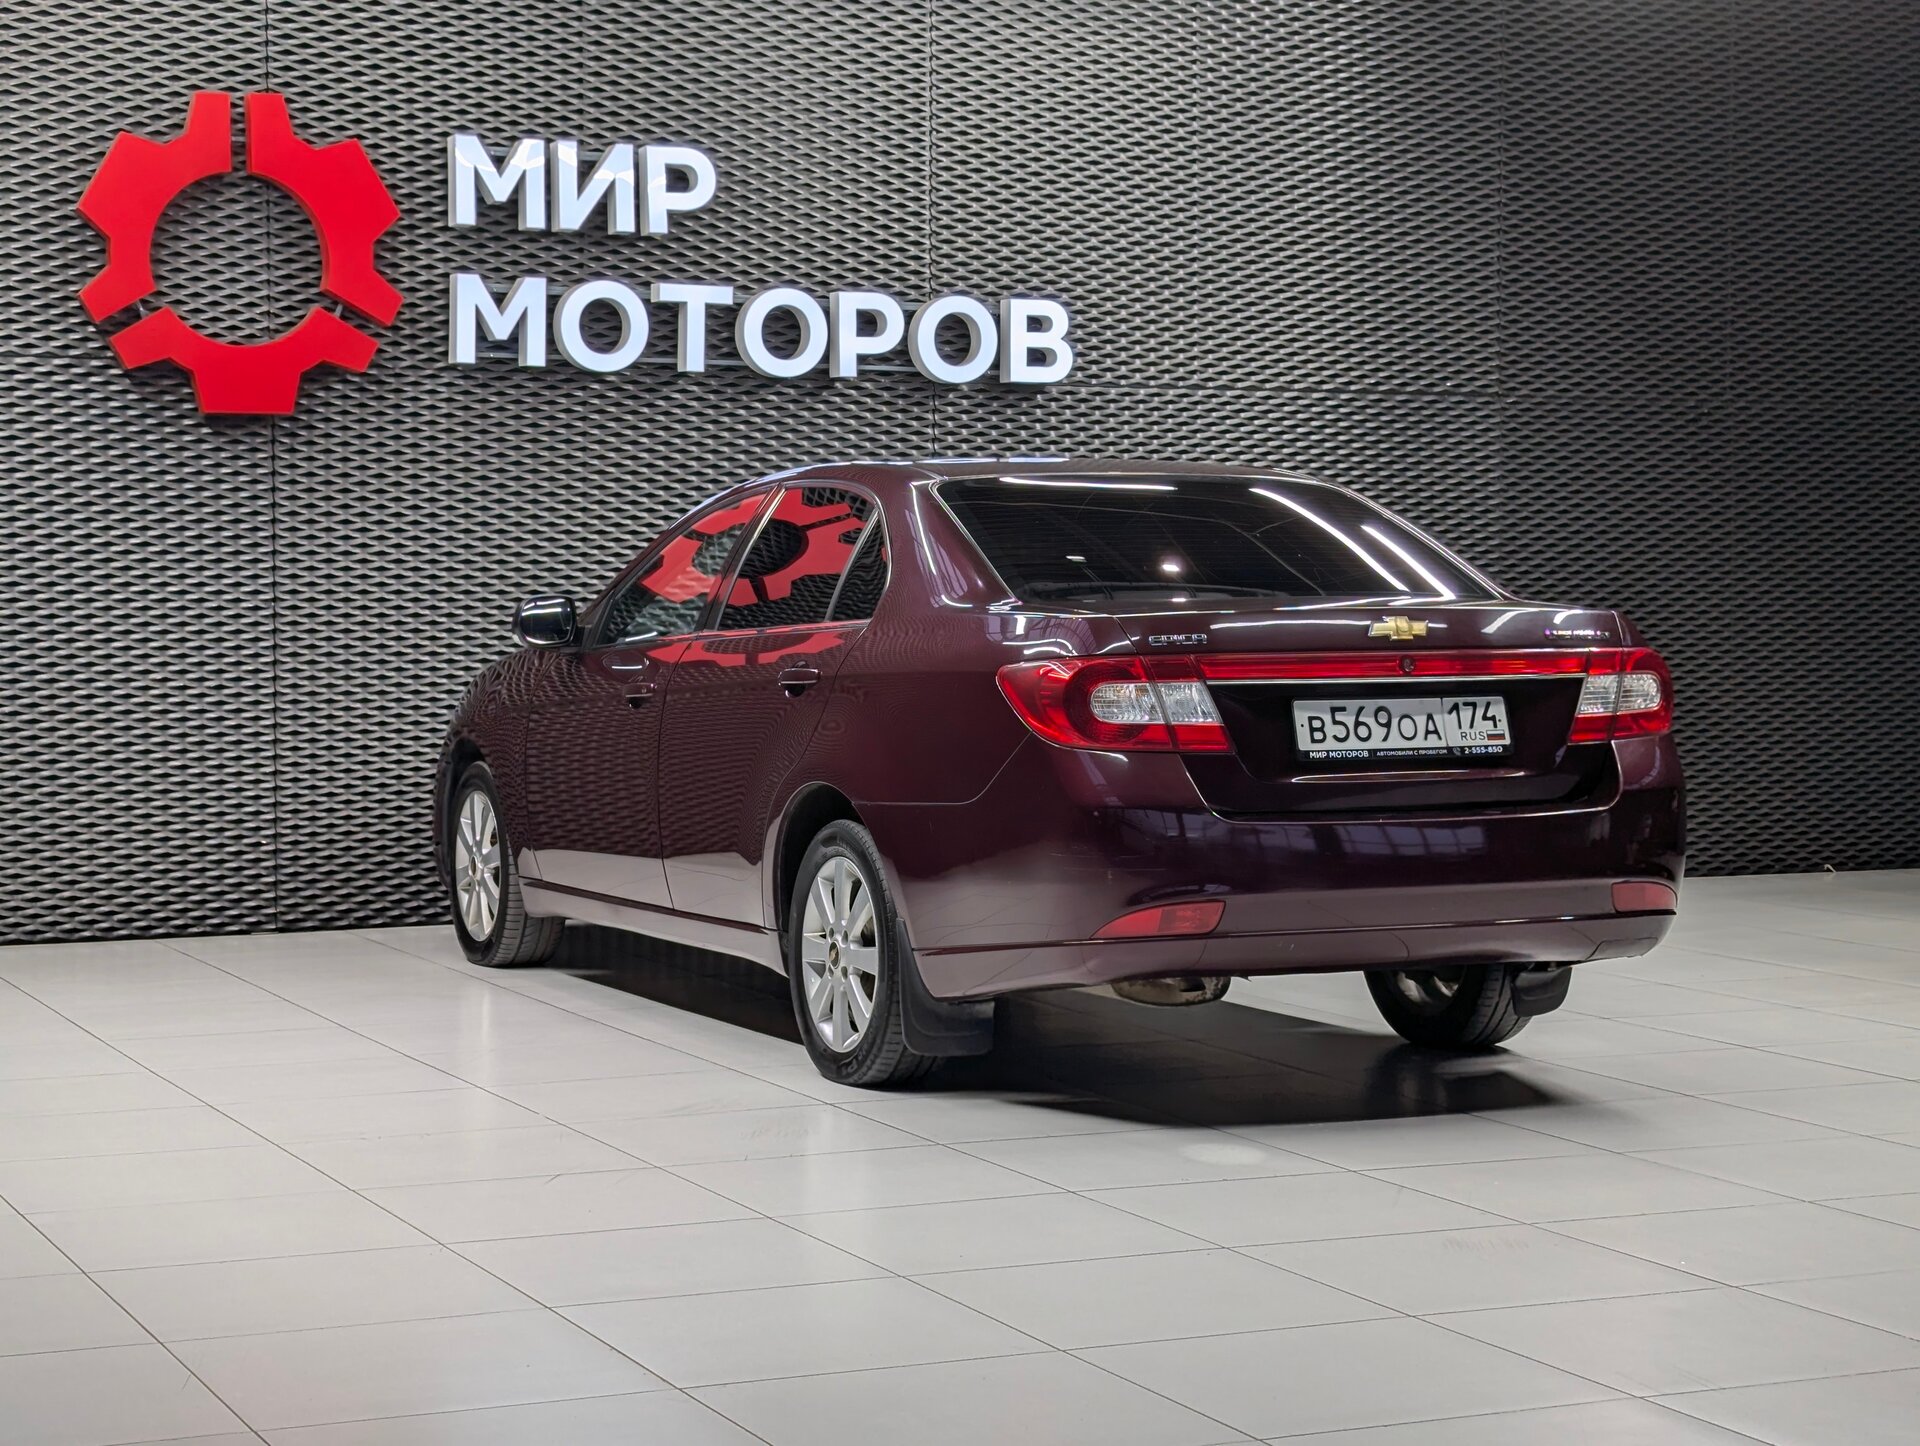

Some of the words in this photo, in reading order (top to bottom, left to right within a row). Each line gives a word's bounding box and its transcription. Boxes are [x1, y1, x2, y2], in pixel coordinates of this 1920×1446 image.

[447, 133, 717, 235] МИР
[448, 272, 1073, 384] МОТОРОВ
[1447, 701, 1498, 730] 174
[1460, 730, 1486, 741] RUS
[1309, 751, 1327, 759] МИР
[1329, 750, 1369, 758] МОТОРОВ
[1464, 745, 1503, 754] 2-555-850
